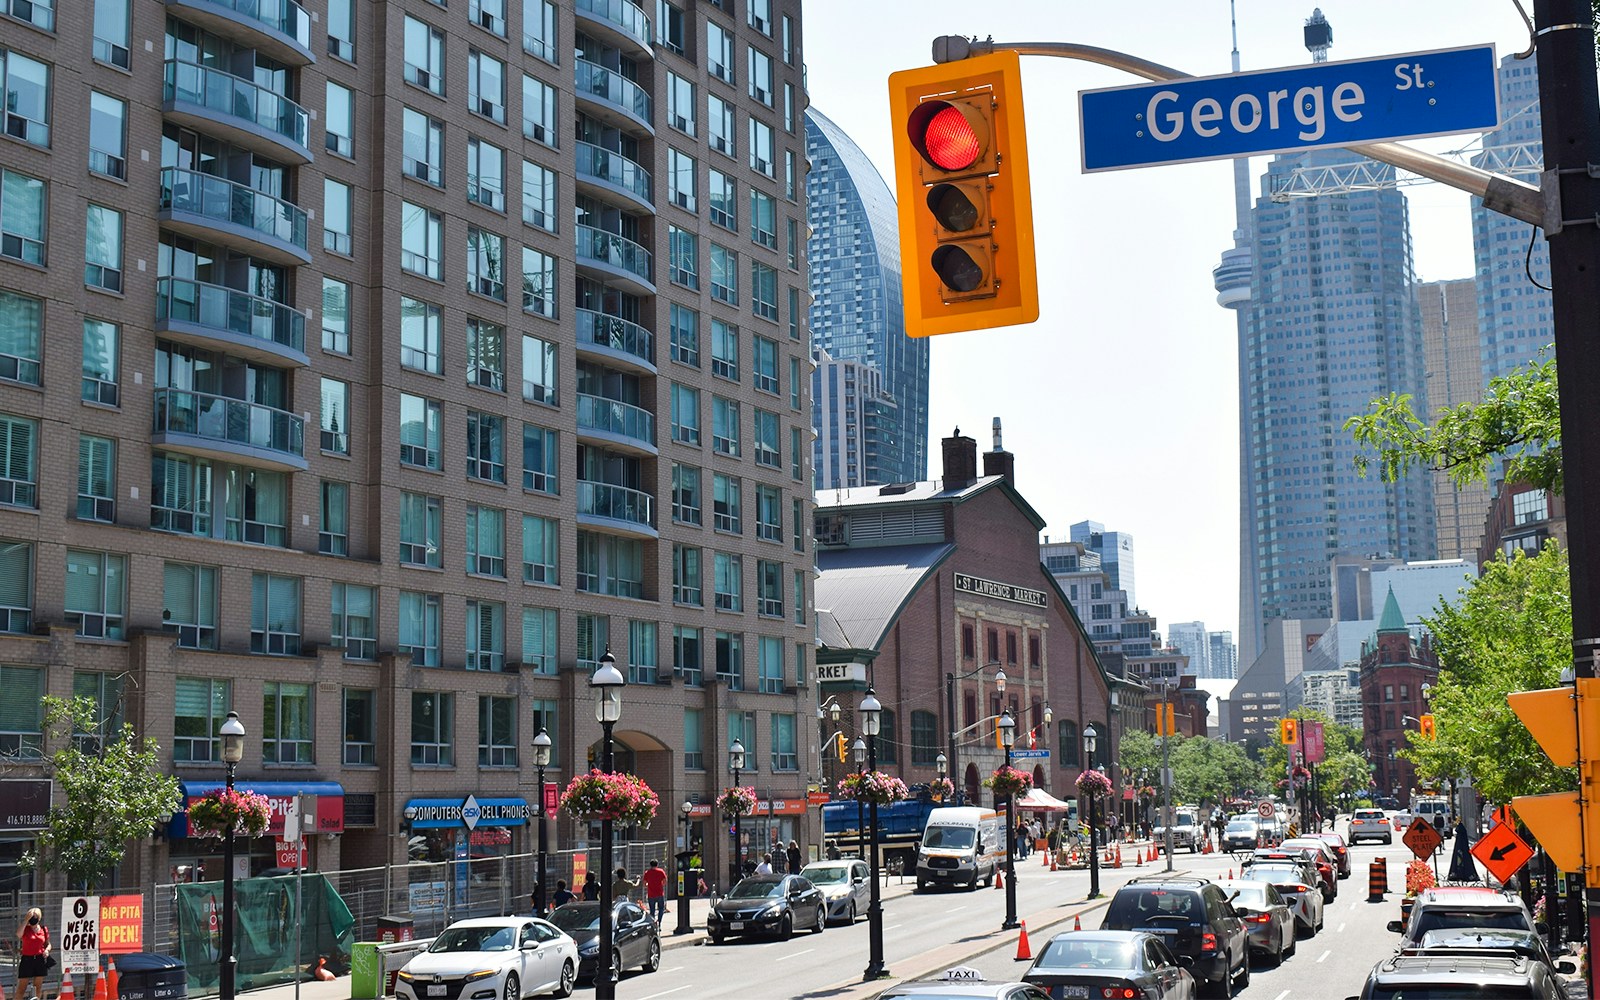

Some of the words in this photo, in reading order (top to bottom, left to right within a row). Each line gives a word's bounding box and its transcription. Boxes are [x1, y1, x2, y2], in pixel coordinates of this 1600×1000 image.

[1146, 81, 1366, 142] George
[974, 579, 1011, 599] LAWRENCE
[1013, 588, 1041, 605] MARKET
[816, 665, 847, 679] RKET
[413, 806, 461, 820] COMPUTERS
[481, 806, 499, 819] CELL
[501, 805, 530, 819] PHONES
[320, 818, 340, 829] Salad
[1412, 834, 1431, 842] STEEL
[275, 842, 289, 851] BIG
[290, 841, 307, 850] PIA
[77, 903, 83, 914] b
[102, 907, 118, 919] BIG
[120, 905, 141, 918] PITA
[67, 920, 95, 933] WE'RE
[102, 925, 139, 944] OPEN!
[63, 933, 97, 951] OPEN
[947, 970, 975, 979] TAXI
[129, 992, 144, 1000] Litter
[154, 989, 167, 998] Litter
